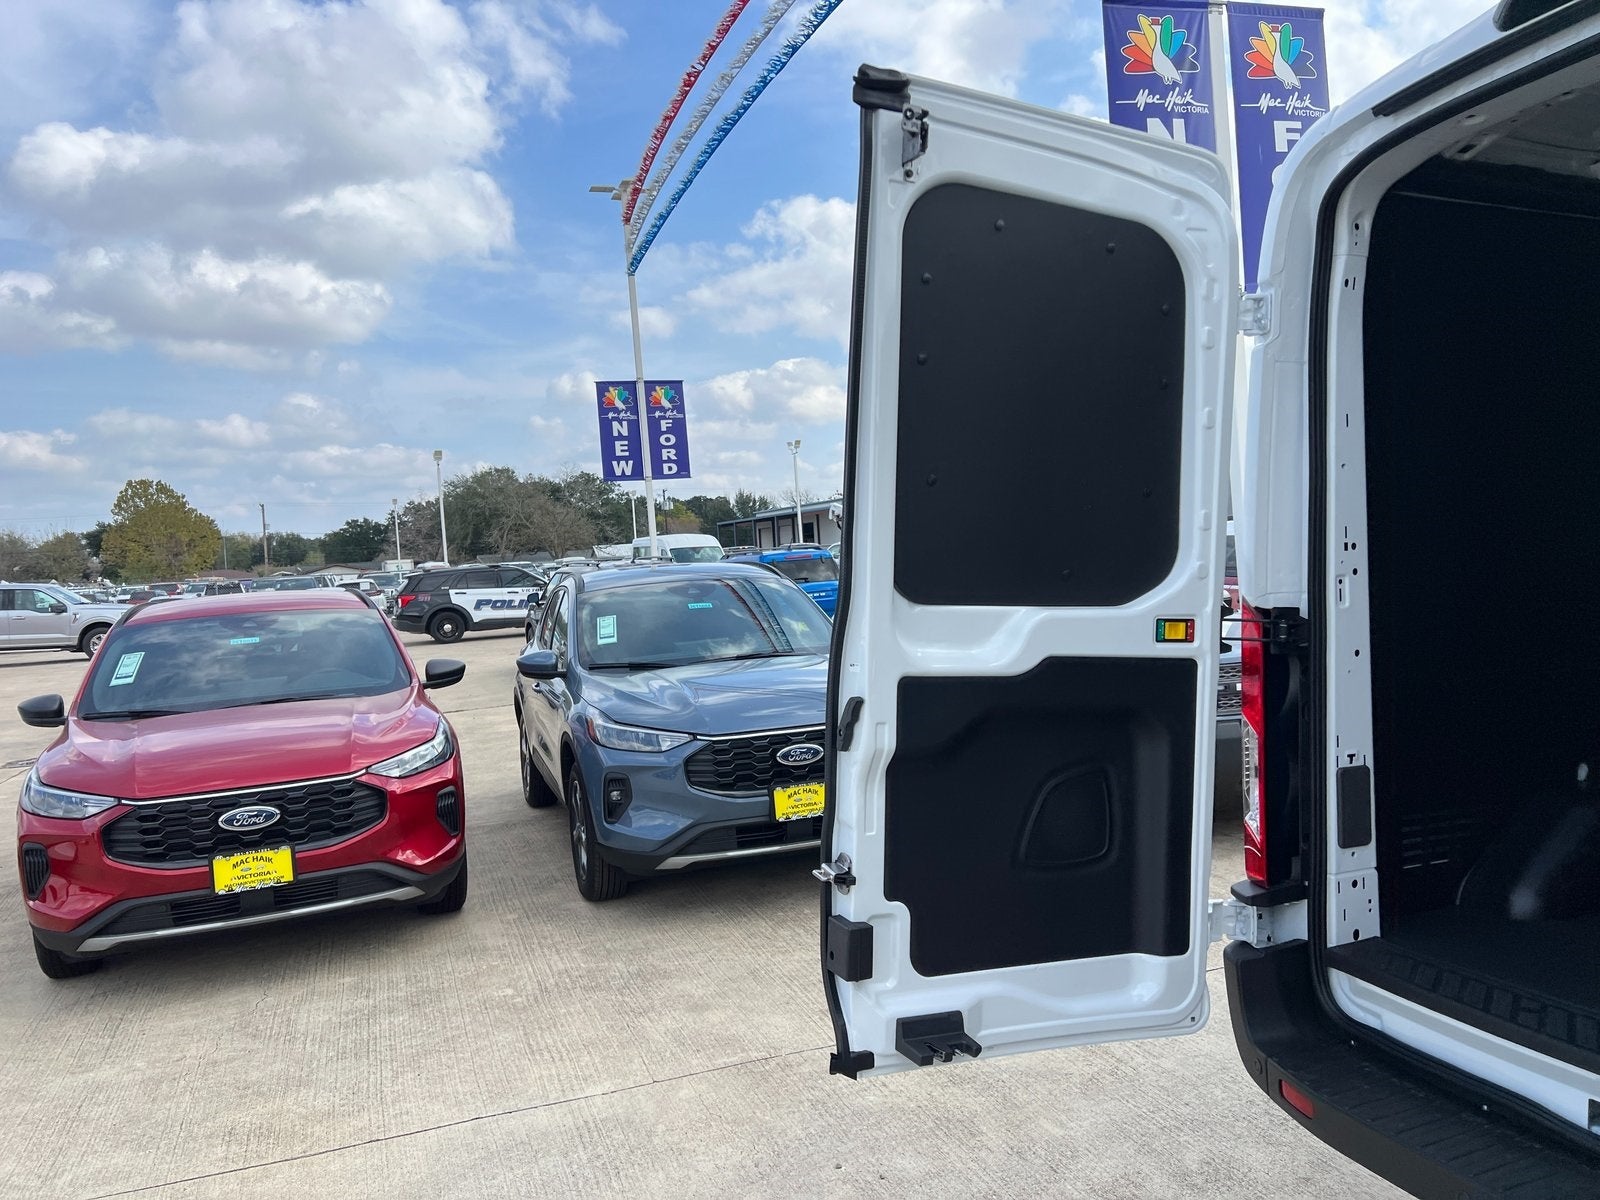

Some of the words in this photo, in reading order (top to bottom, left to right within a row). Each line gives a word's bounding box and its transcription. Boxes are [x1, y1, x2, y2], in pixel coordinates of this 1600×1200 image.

[1120, 88, 1163, 111] Mac
[1164, 86, 1204, 112] Haik
[1244, 92, 1284, 115] Mac
[1285, 91, 1321, 115] Haik
[1173, 105, 1209, 114] VICTORIA
[611, 420, 633, 476] NEW
[659, 419, 678, 475] FORD
[474, 598, 528, 611] POLI
[788, 748, 814, 761] Ford
[787, 789, 801, 800] MAC
[802, 787, 819, 795] HAIK
[233, 811, 266, 826] Ford
[232, 856, 250, 870] MAC
[252, 855, 274, 864] HAIK
[236, 870, 272, 880] VICTORIA
